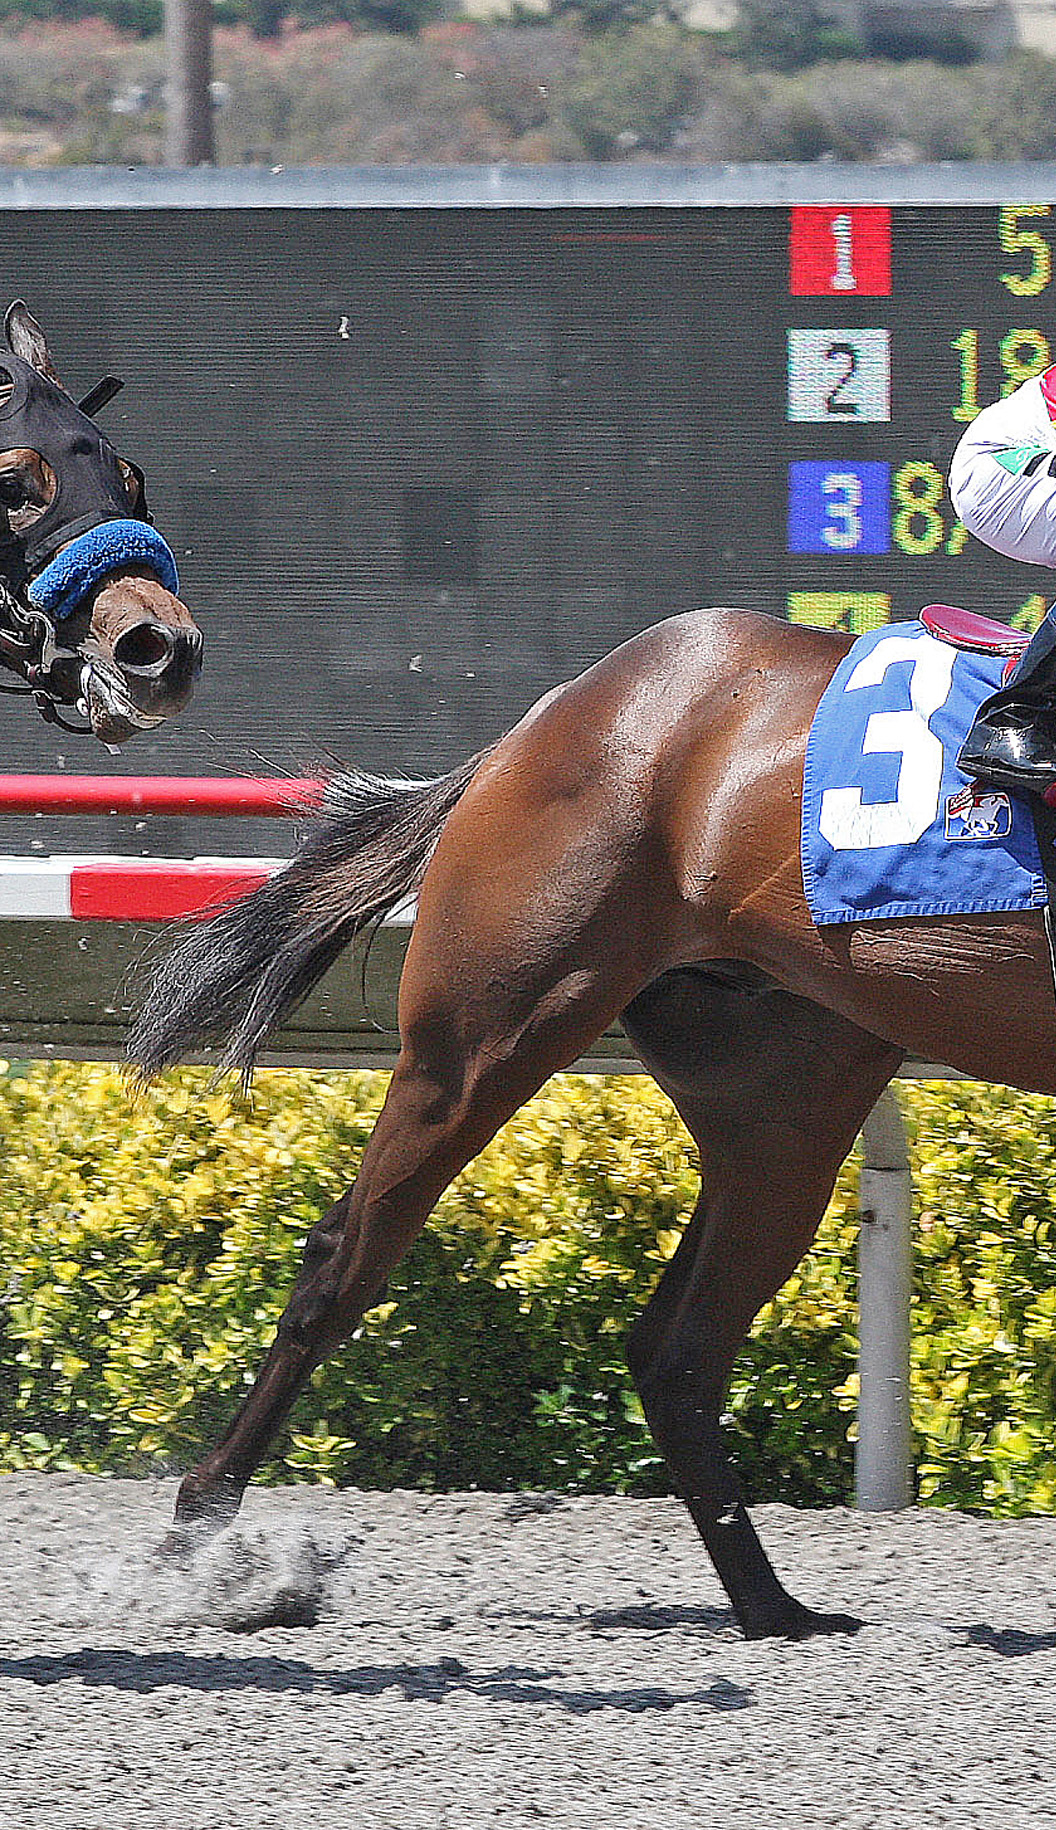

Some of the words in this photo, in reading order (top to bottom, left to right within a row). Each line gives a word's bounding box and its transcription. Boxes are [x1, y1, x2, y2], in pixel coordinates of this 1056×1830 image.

[831, 213, 857, 291] 1
[999, 204, 1051, 297] 5
[826, 343, 857, 413] 2
[822, 472, 864, 550] 3
[818, 633, 958, 851] 3
